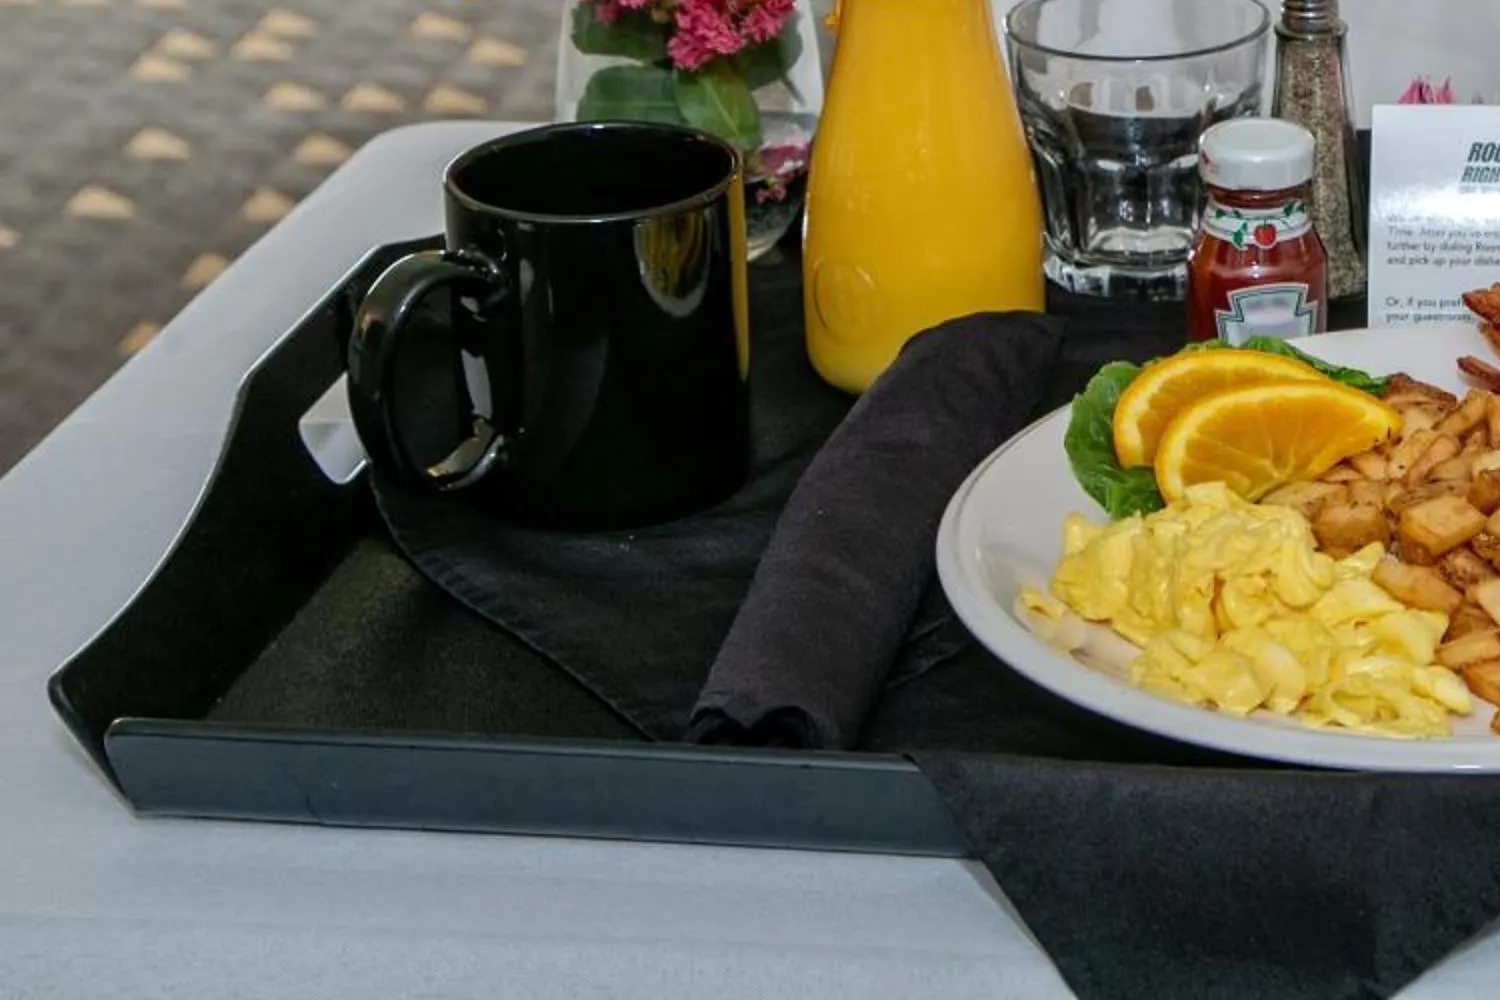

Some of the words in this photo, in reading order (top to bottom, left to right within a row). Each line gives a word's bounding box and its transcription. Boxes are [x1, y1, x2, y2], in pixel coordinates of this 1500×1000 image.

[1423, 241, 1436, 254] by
[1387, 256, 1407, 266] and
[1409, 256, 1429, 268] pick
[1432, 257, 1447, 268] up
[1449, 258, 1472, 268] your
[1417, 298, 1437, 309] you
[1386, 313, 1409, 323] your
